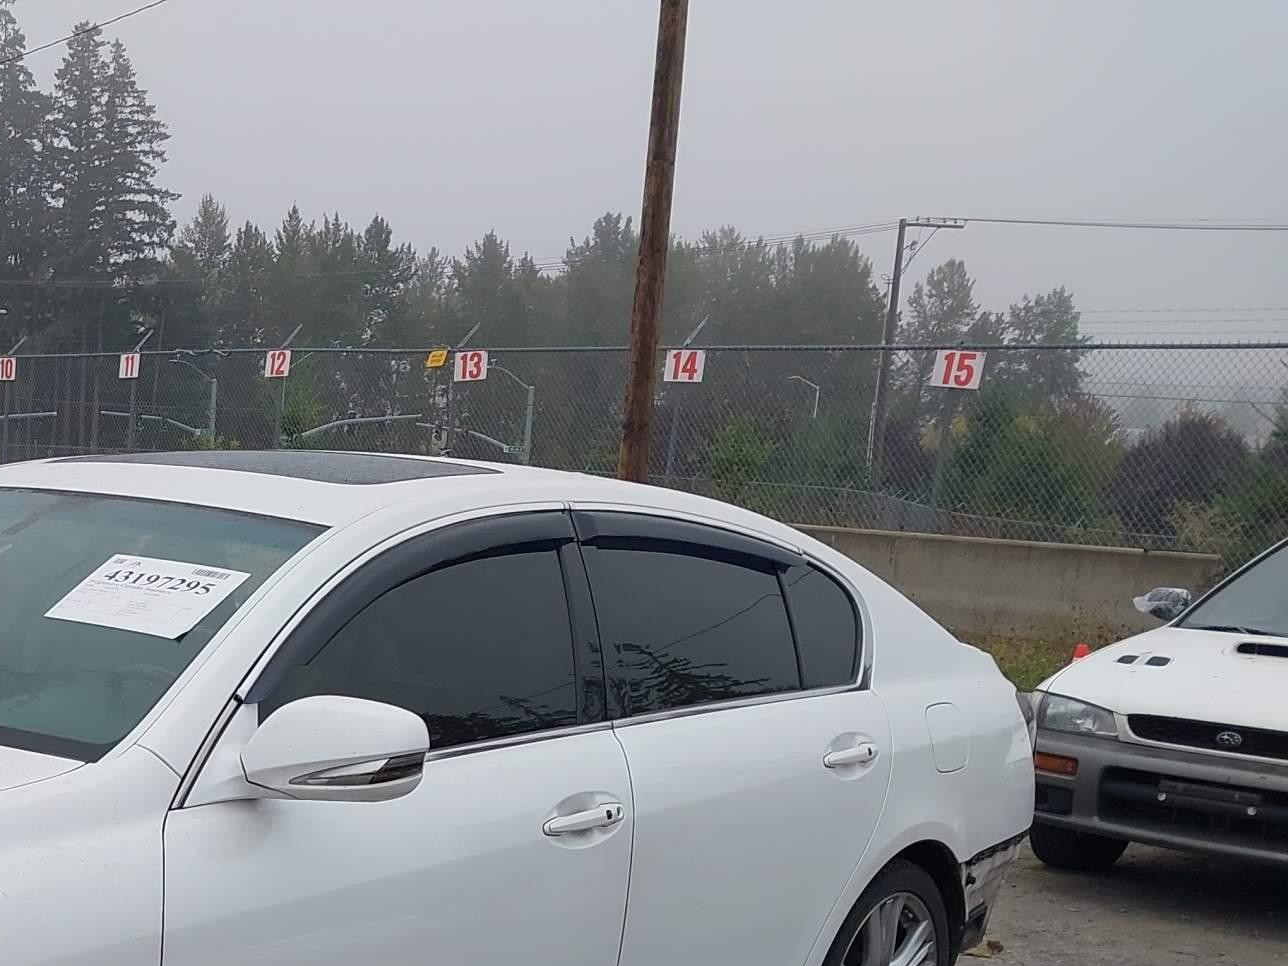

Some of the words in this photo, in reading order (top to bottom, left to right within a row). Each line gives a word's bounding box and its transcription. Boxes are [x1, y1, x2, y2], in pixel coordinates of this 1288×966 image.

[0, 358, 13, 379] 10
[124, 354, 136, 377] 11
[270, 351, 287, 376] 12
[459, 352, 483, 380] 13
[672, 352, 698, 380] 14
[942, 352, 977, 387] 15
[103, 569, 217, 595] 43197295
